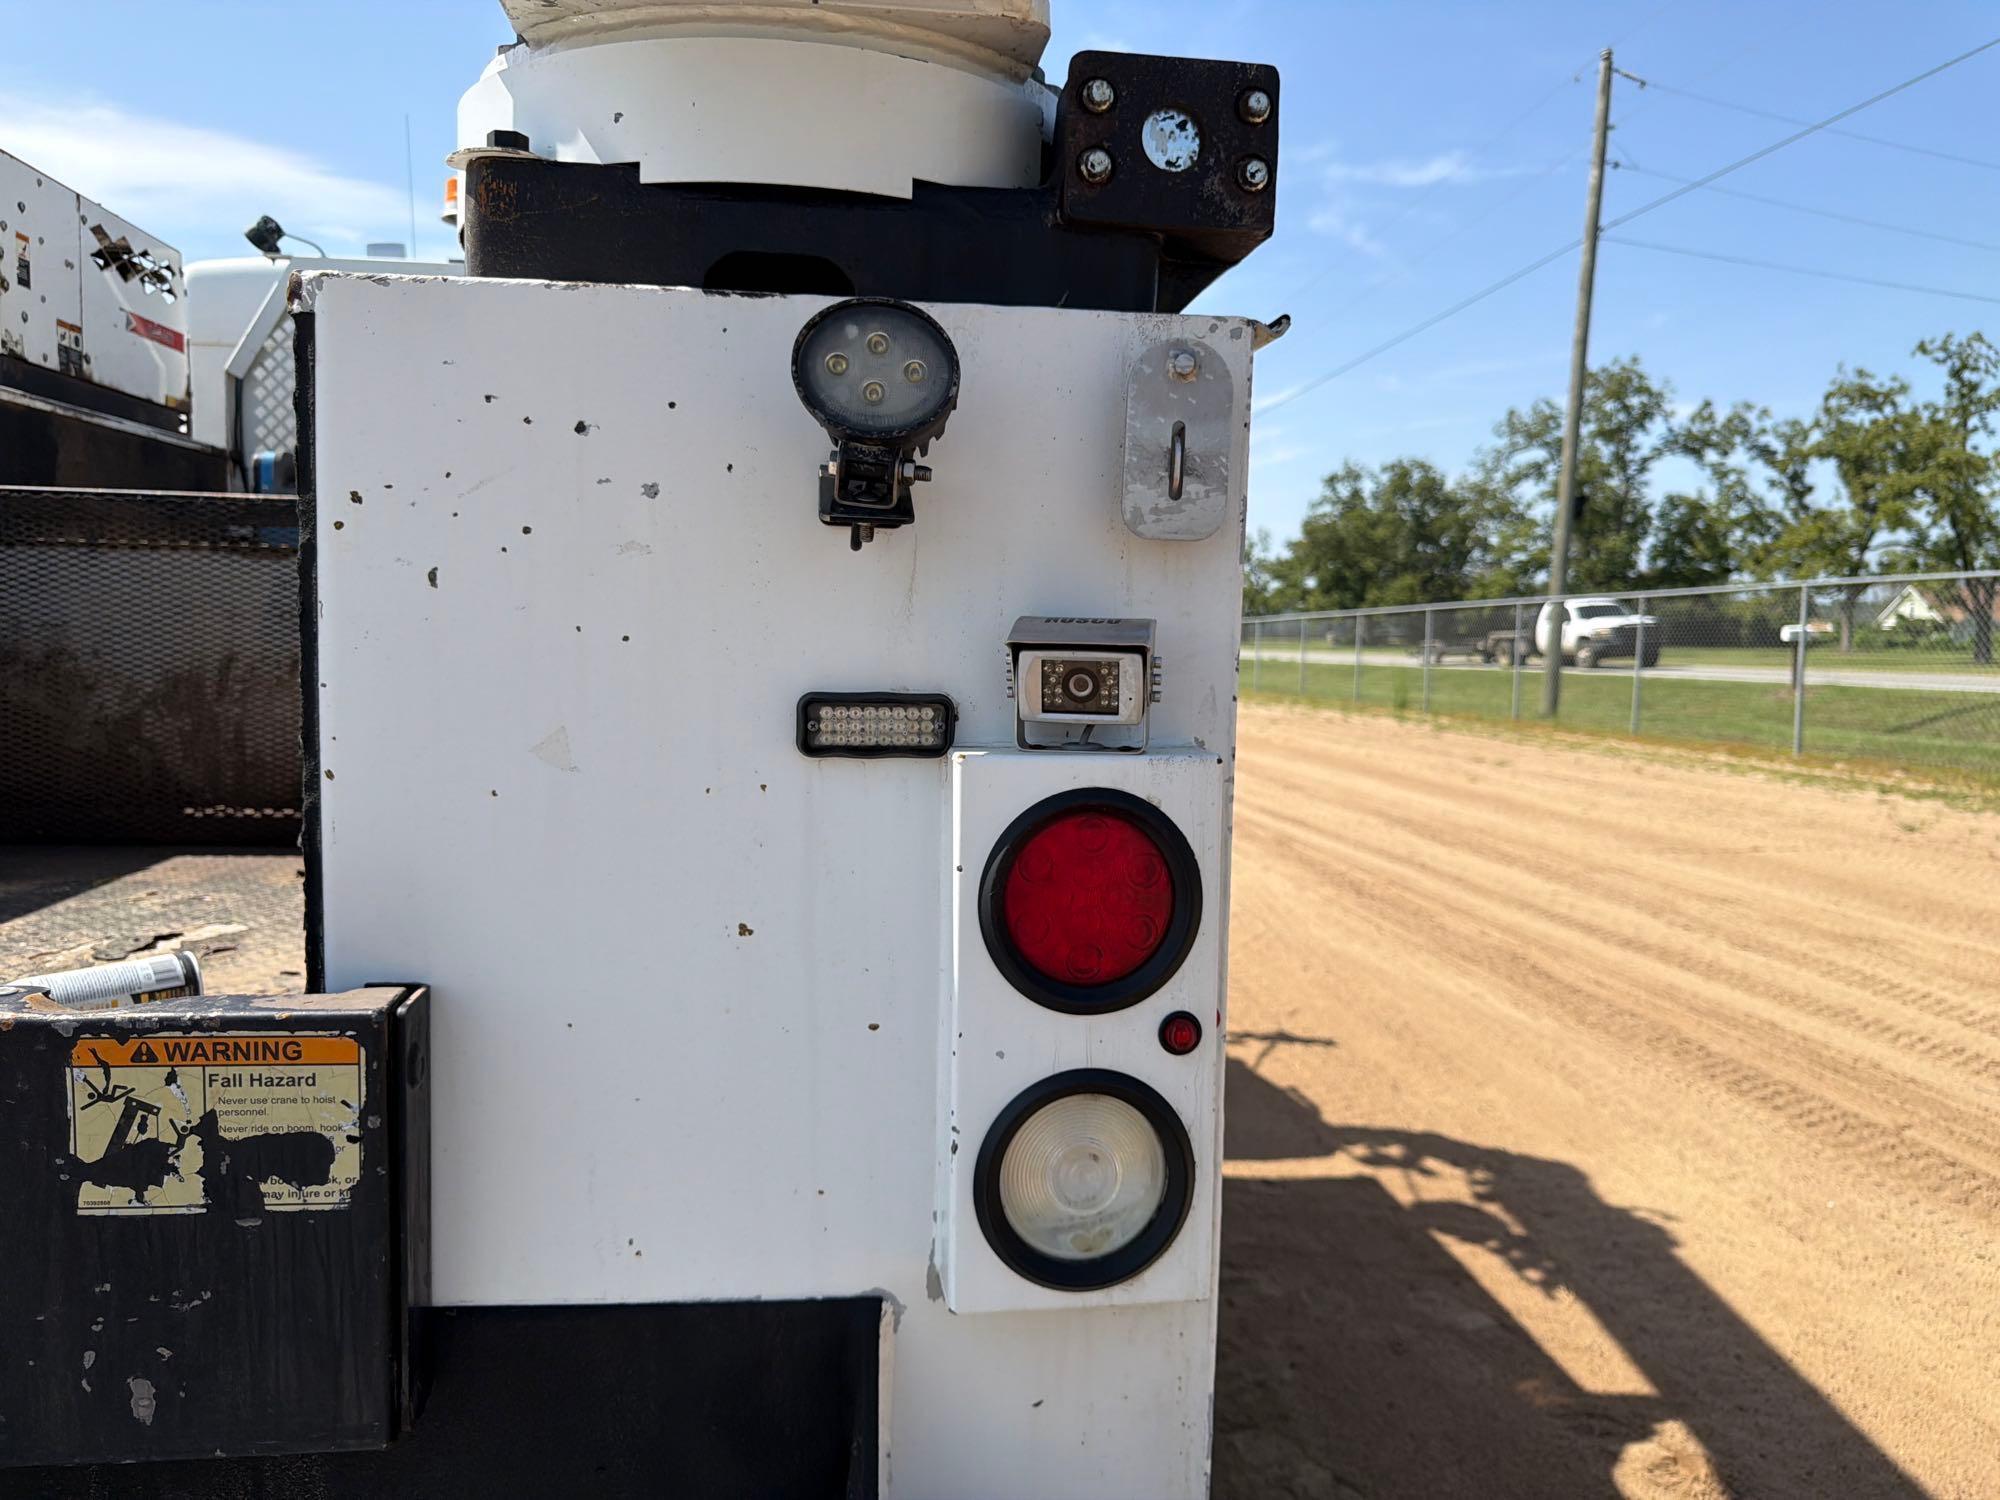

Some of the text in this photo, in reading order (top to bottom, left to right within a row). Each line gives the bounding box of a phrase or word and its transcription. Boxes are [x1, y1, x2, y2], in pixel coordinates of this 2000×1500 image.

[163, 1040, 304, 1062] WARNING
[208, 1072, 317, 1088] Fall Hazard
[217, 1095, 336, 1105] Never use crane to hoist
[218, 1107, 269, 1118] personnel.
[218, 1124, 249, 1133] Never
[251, 1124, 269, 1133] ride
[287, 1188, 321, 1200] injure
[323, 1190, 338, 1198] or
